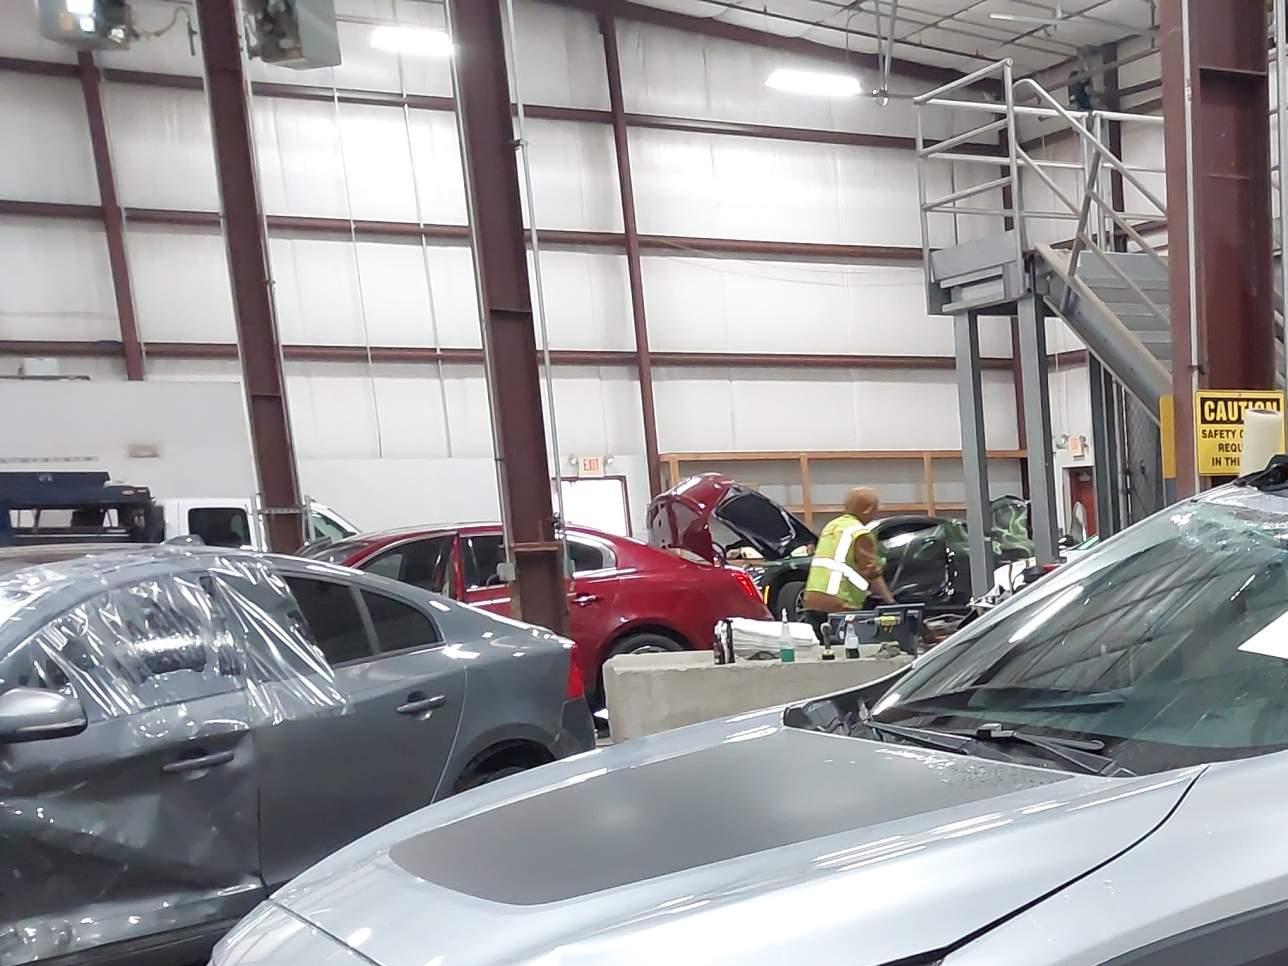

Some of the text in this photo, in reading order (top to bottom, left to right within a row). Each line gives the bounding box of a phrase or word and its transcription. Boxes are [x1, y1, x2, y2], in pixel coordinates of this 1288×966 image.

[1201, 429, 1237, 439] SAFETY
[1218, 443, 1243, 453] REQU
[1211, 456, 1241, 467] IN THI
